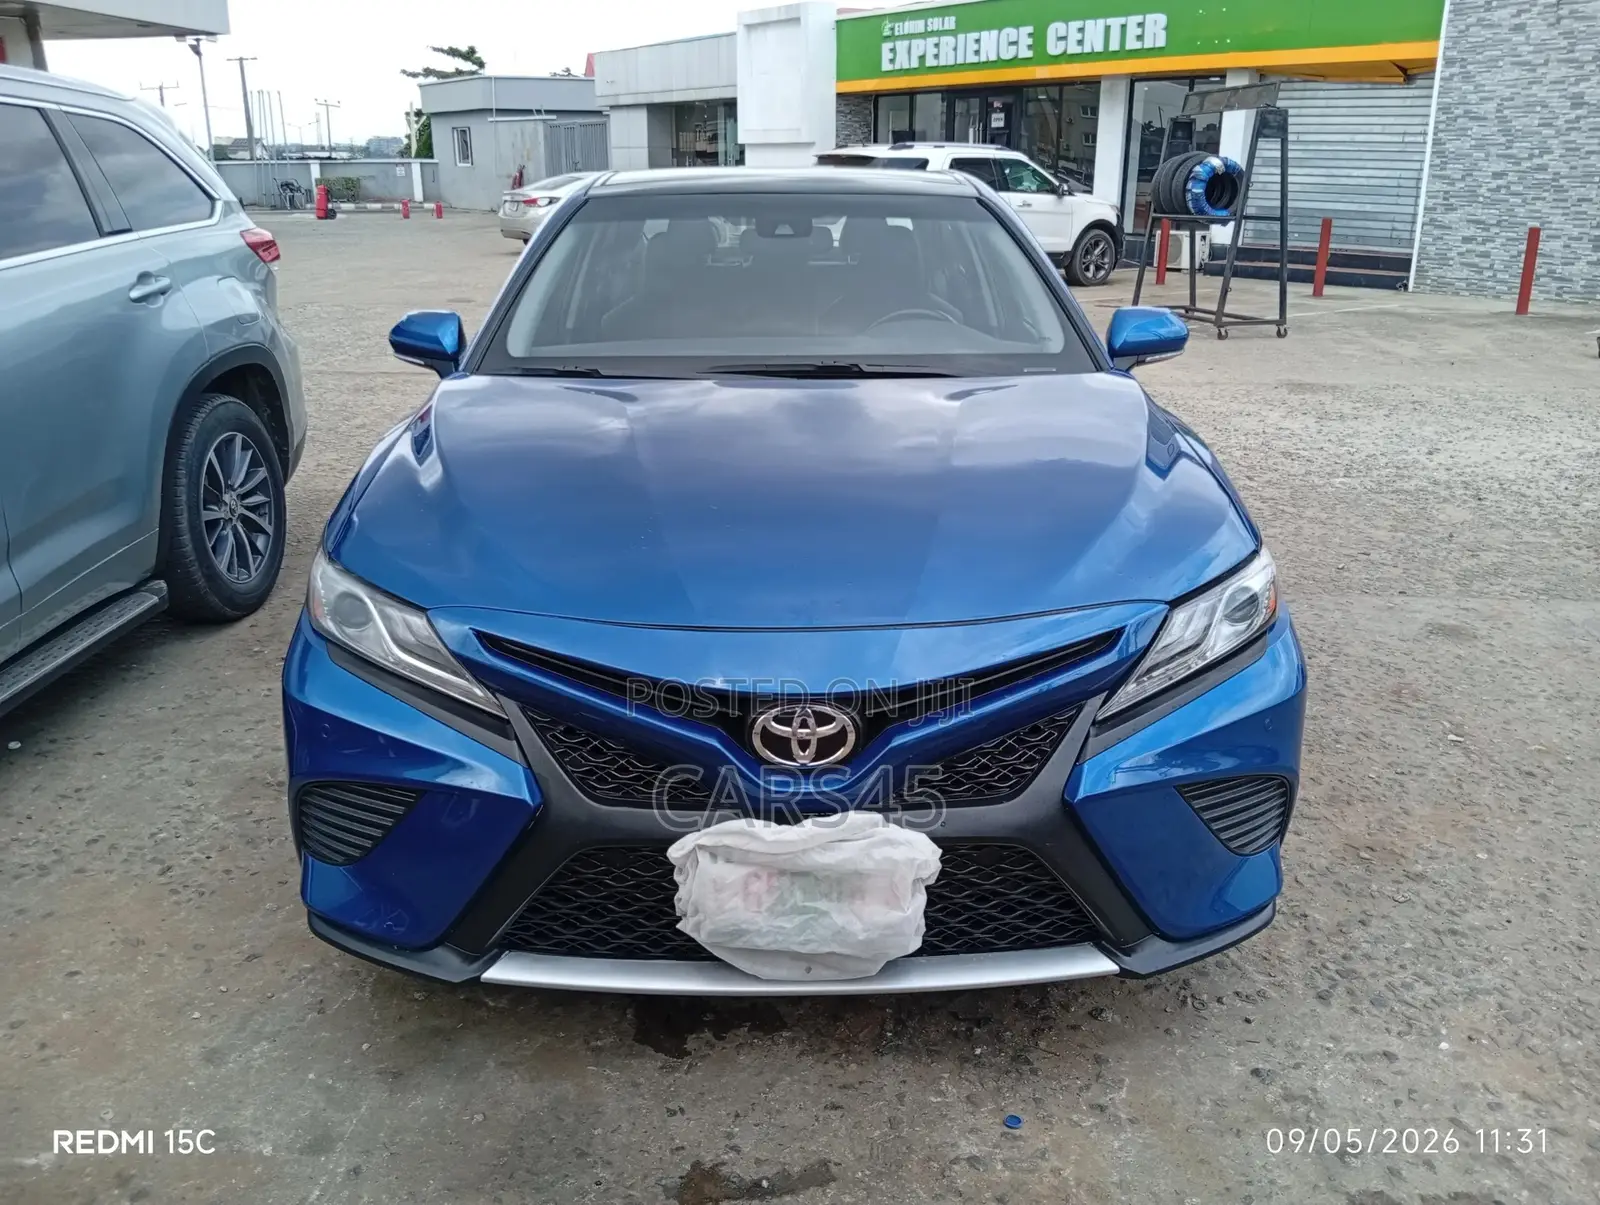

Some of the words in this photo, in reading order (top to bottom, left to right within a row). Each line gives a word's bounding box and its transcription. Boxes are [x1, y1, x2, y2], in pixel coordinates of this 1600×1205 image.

[880, 25, 1035, 72] EXPERIENCE
[1046, 12, 1168, 56] CENTER
[926, 16, 957, 33] SOLAR
